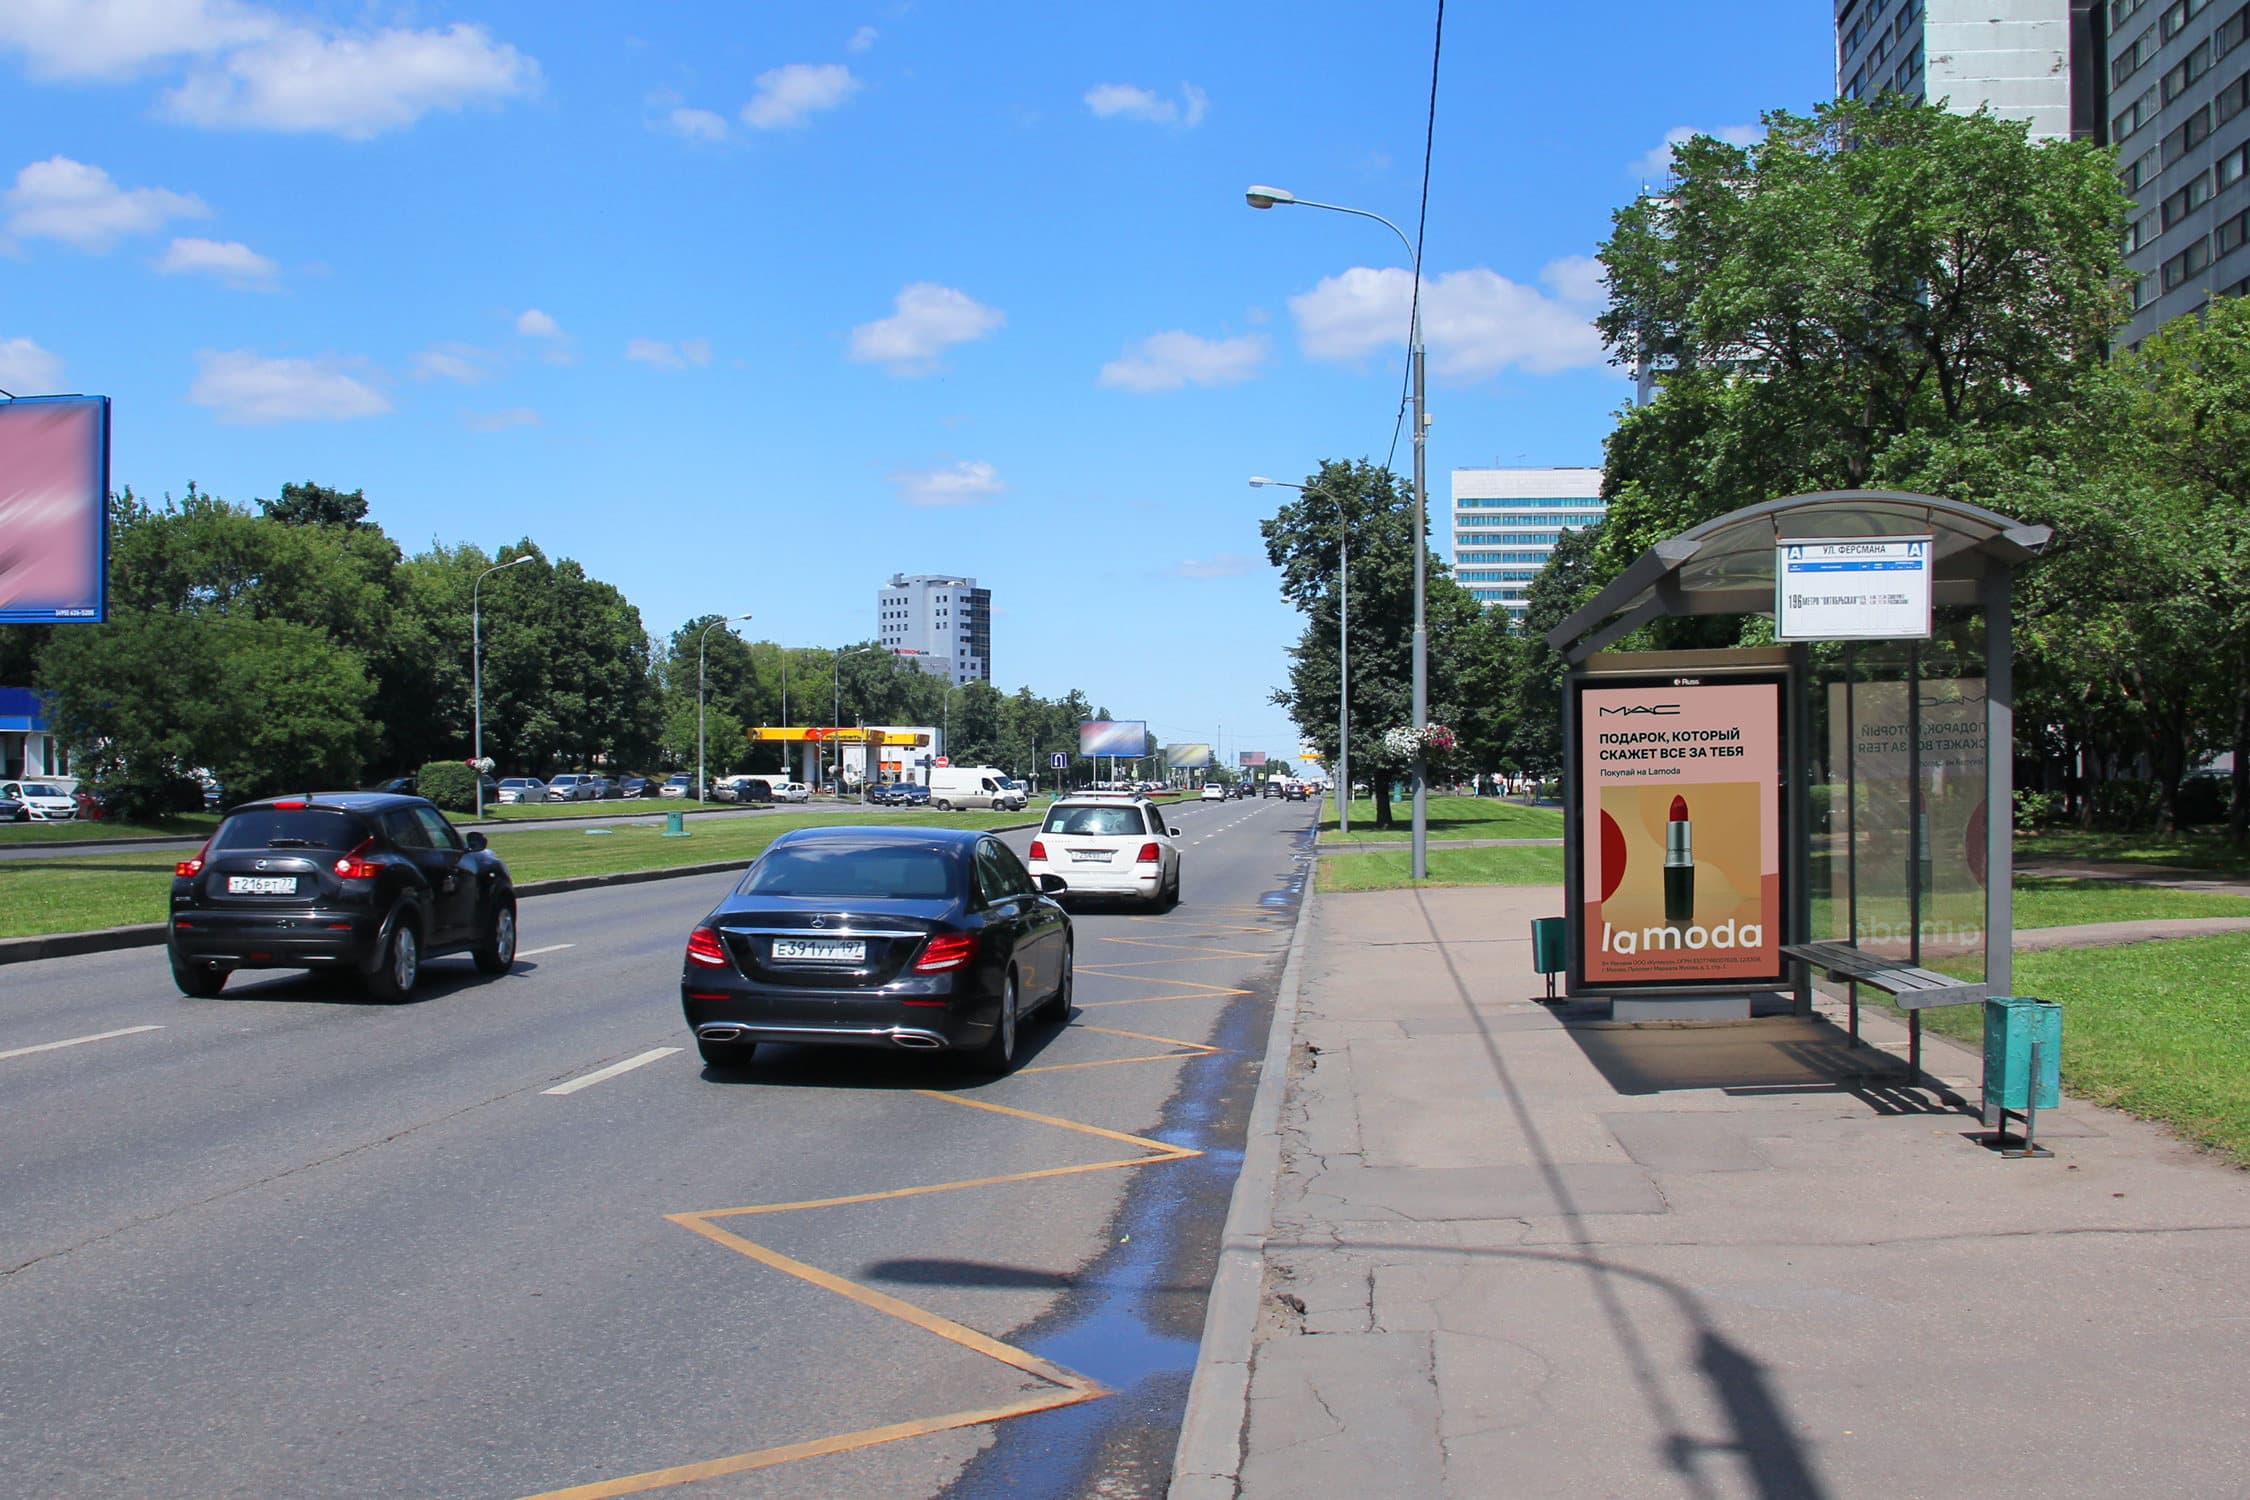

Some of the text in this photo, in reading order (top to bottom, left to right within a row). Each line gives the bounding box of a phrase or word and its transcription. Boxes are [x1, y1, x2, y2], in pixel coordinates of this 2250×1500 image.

[1823, 546, 1836, 555] УЛ.
[1838, 545, 1886, 555] ФЕРСМАНА
[1788, 594, 1802, 609] 196
[1600, 727, 1740, 746] ПОДАРОК, КОТОРЫЙ
[1600, 746, 1744, 761] СКАЖЕТ ВСЕ ЗА ТЕБЯ
[1600, 768, 1635, 779] Покупай
[1648, 767, 1681, 776] Lamoda
[234, 878, 293, 890] Т216РТ 77
[1602, 918, 1763, 955] lamoda
[778, 941, 861, 956] Е391УУ 197
